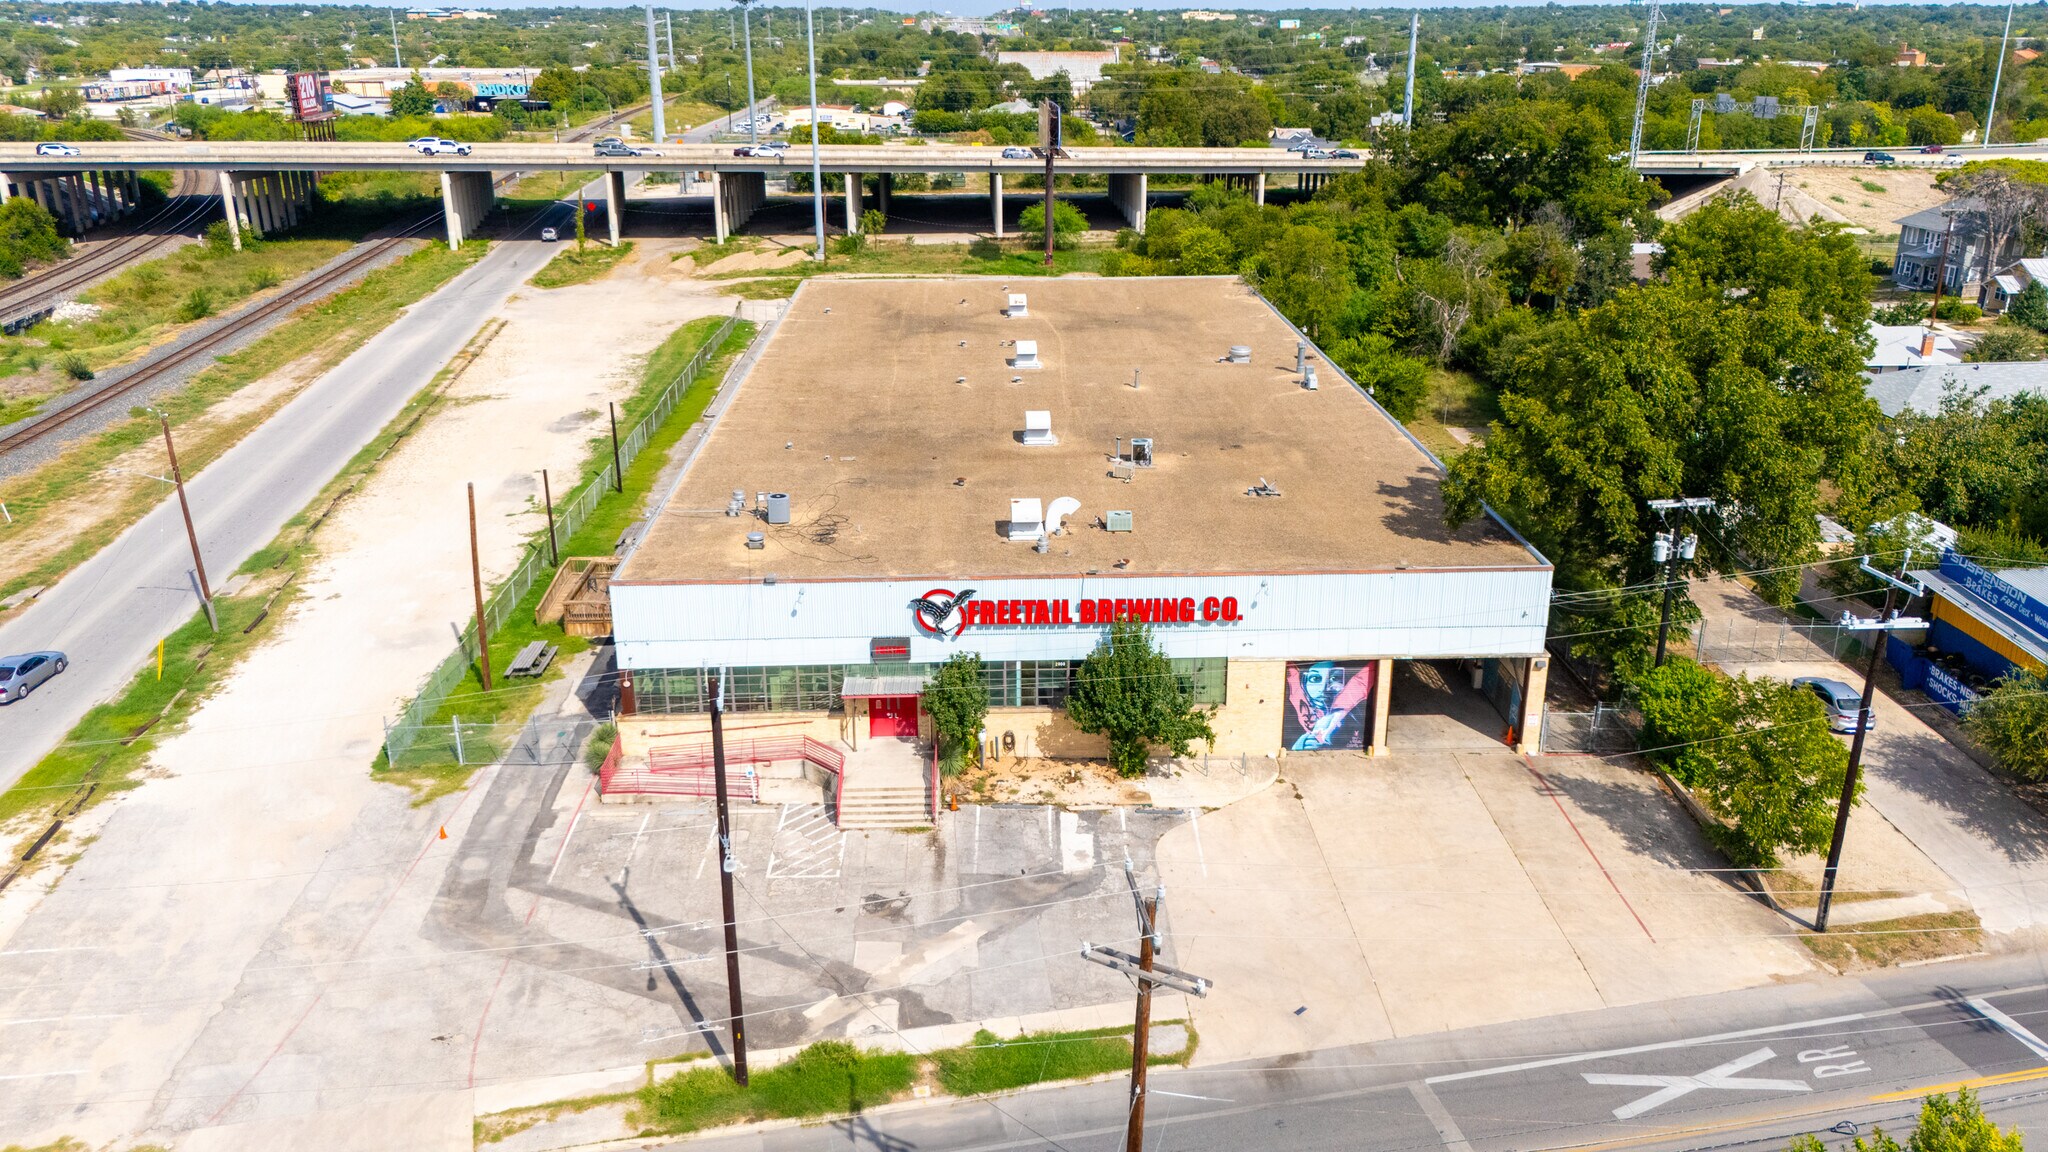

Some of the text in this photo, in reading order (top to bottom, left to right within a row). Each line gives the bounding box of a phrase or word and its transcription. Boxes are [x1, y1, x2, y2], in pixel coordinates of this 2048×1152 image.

[299, 74, 315, 98] 210
[1950, 552, 2027, 604] SUSPENSION
[1965, 576, 1999, 605] BRAKES
[1978, 579, 1992, 590] AND
[967, 596, 1244, 624] FREETAIL BREWING CO.
[2000, 595, 2019, 610] FREE
[1928, 677, 1958, 704] SHOCKS
[1930, 665, 1958, 691] BRAKES
